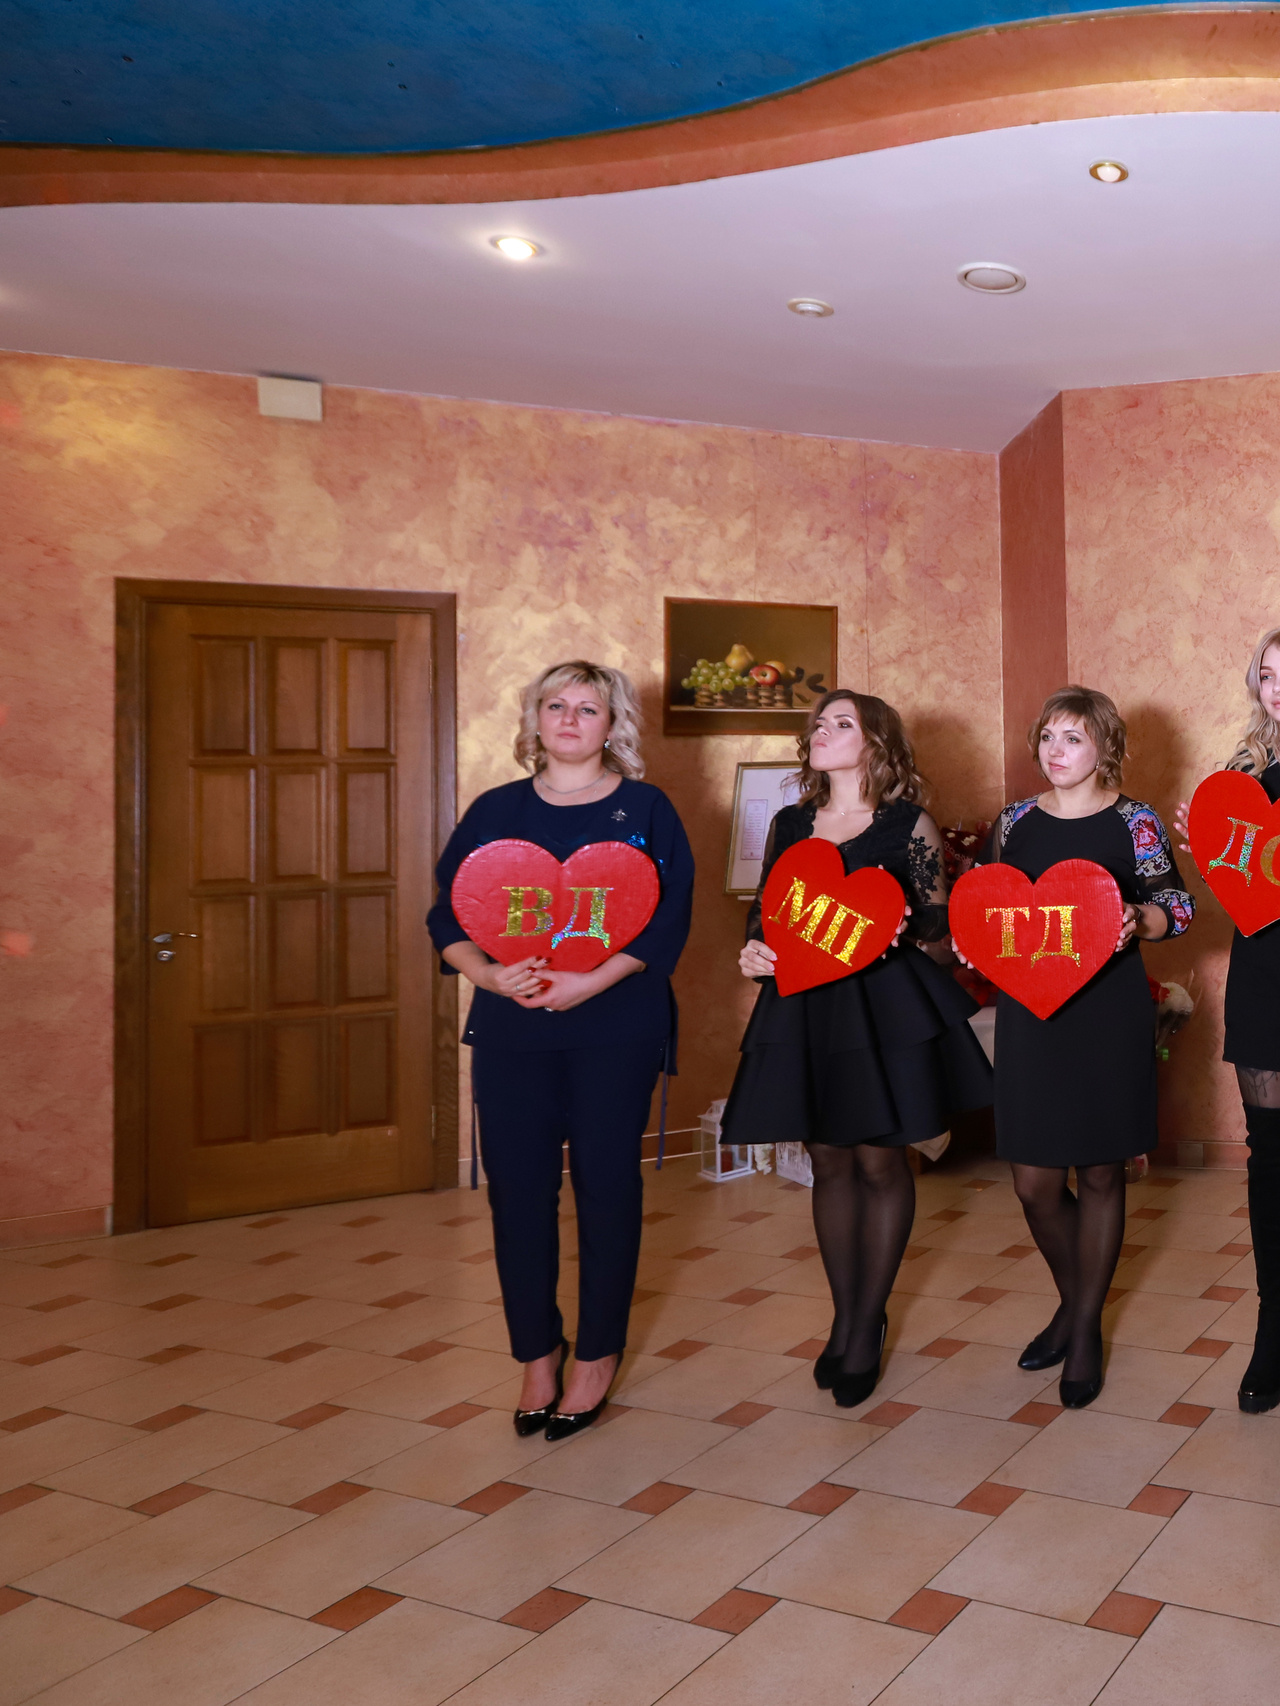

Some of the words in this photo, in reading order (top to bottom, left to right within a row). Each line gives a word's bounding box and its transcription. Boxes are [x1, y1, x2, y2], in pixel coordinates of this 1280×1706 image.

[499, 886, 614, 949] ВД
[768, 876, 874, 967] МП
[985, 905, 1080, 969] ТД
